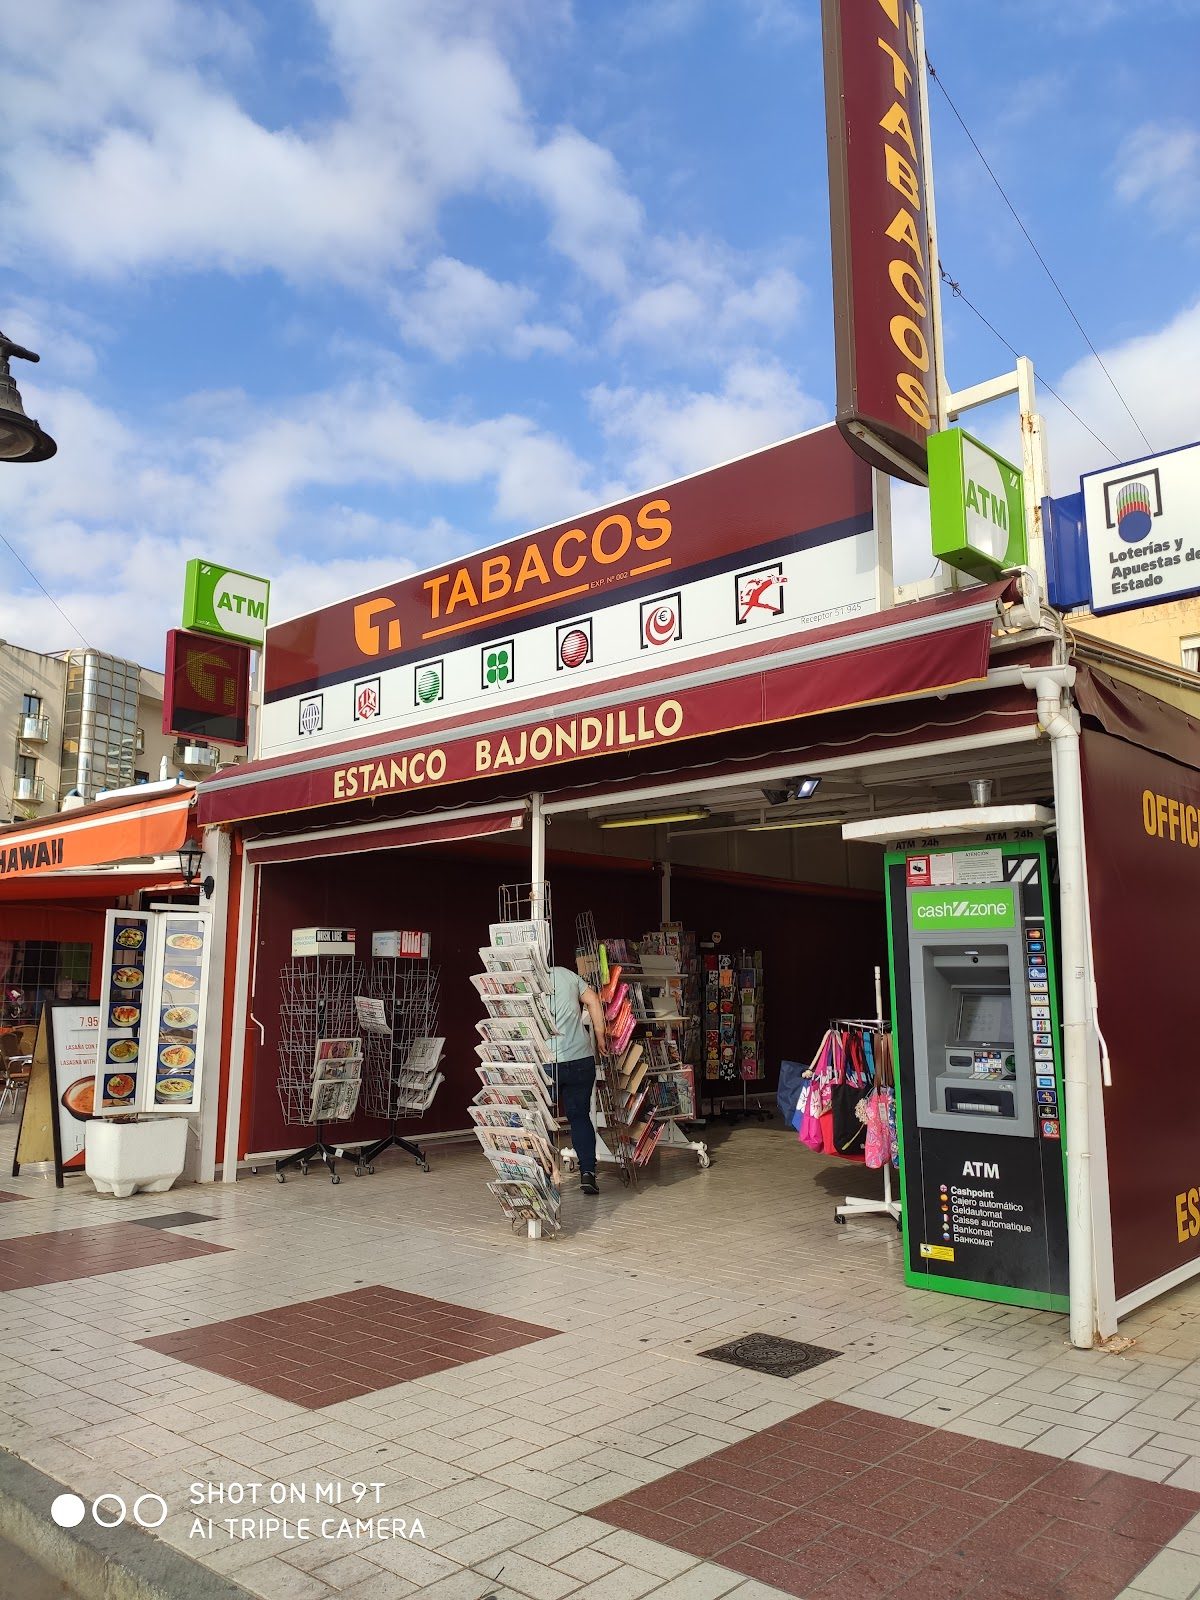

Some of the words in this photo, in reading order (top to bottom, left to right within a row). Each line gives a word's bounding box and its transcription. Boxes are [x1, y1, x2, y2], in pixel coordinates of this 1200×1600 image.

[877, 36, 932, 430] TABACOS
[966, 478, 1007, 531] ATM
[423, 499, 673, 619] TABACOS
[1109, 541, 1171, 564] Loterías
[1174, 537, 1184, 552] y
[1111, 554, 1181, 580] Apuestas
[590, 578, 605, 589] EXP.
[615, 571, 628, 581] 002
[1111, 573, 1164, 595] Estado
[217, 591, 264, 620] ATM
[800, 612, 832, 624] Receptor
[333, 749, 447, 799] ESTANCO
[475, 700, 684, 772] BAJONDILLO
[896, 840, 916, 851] ATM
[921, 837, 940, 848] 24h
[985, 832, 1007, 842] ATM
[1013, 829, 1034, 840] 24h
[917, 901, 953, 918] cash
[970, 902, 1007, 916] zone
[401, 931, 421, 953] Bild
[80, 1016, 99, 1027] 7.95
[962, 1160, 1000, 1180] ATM
[950, 1185, 994, 1199] Cashpoint
[951, 1195, 977, 1208] Cajero
[978, 1199, 1023, 1212] automático
[951, 1205, 1003, 1220] Geldautomat
[952, 1214, 980, 1226] Caisse
[981, 1218, 1032, 1233] automatique
[1175, 1186, 1200, 1243] ES
[953, 1224, 993, 1238] Bankomat
[953, 1234, 994, 1247] Банкомат
